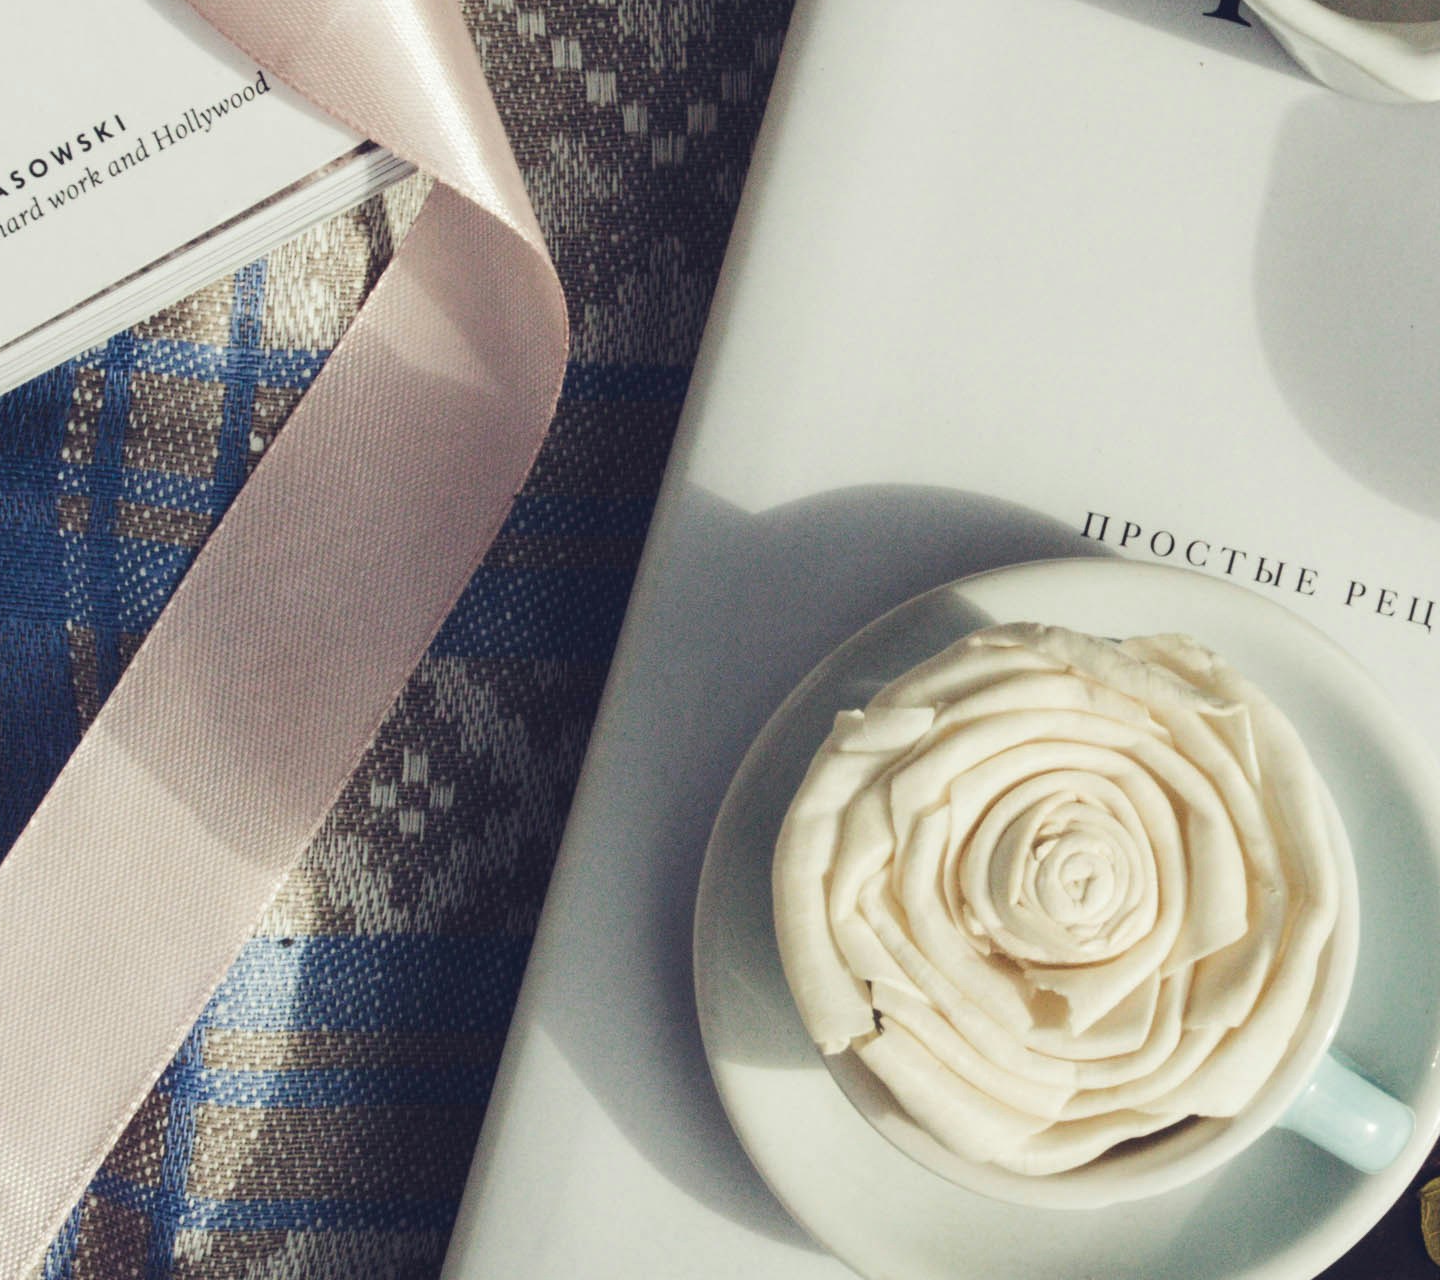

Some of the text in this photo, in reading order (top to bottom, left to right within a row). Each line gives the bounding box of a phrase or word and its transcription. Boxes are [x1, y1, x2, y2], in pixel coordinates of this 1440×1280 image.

[47, 166, 104, 209] work
[107, 137, 151, 178] and
[151, 67, 273, 153] Hollywood
[1080, 510, 1319, 596] ПРОСТЫЕ
